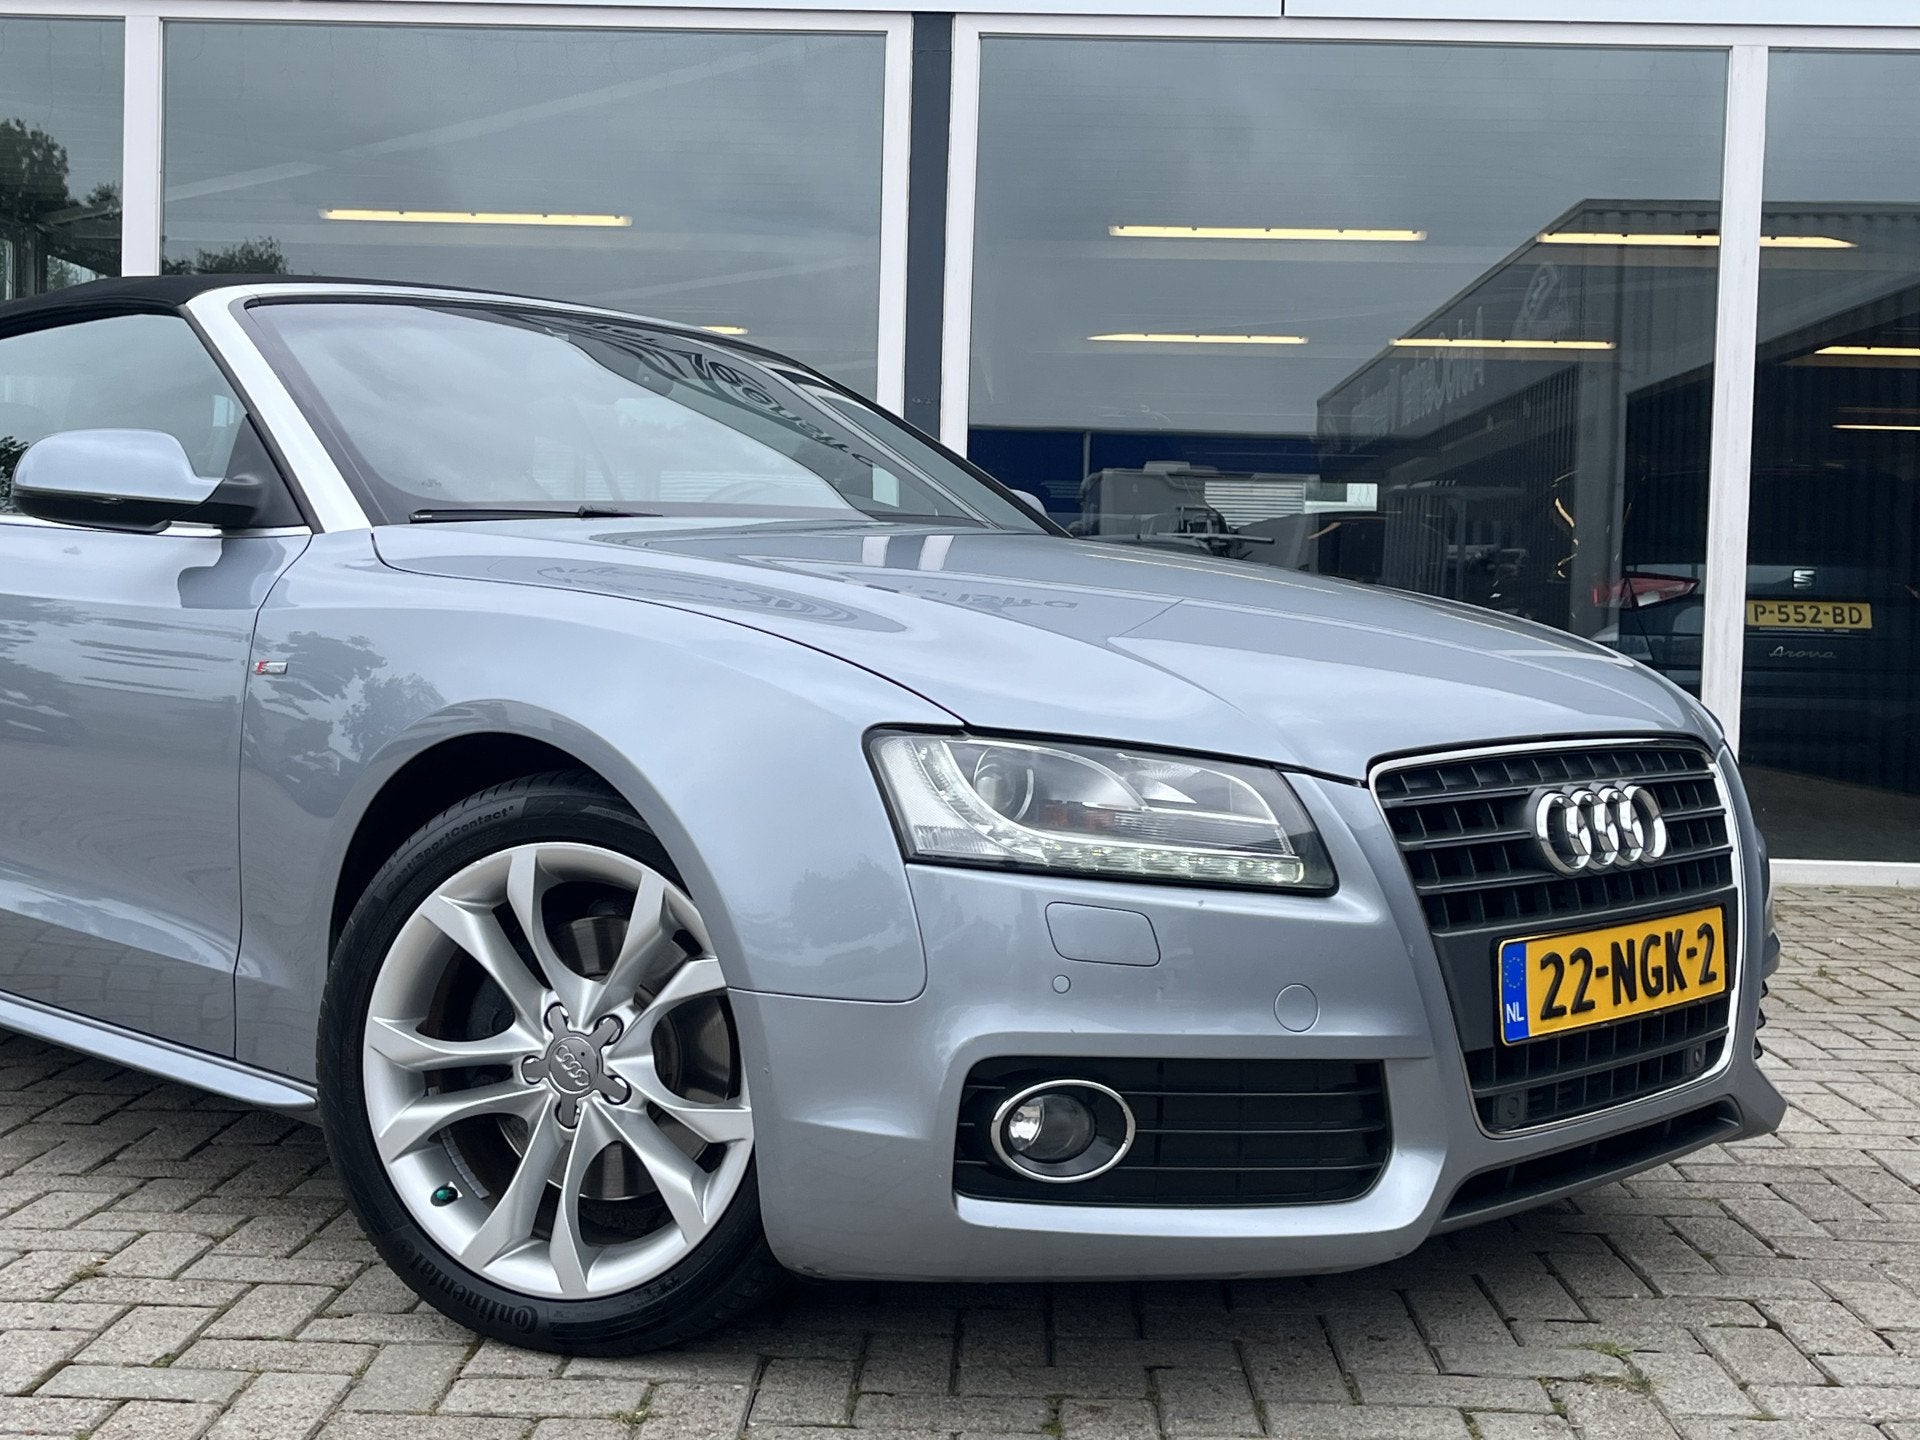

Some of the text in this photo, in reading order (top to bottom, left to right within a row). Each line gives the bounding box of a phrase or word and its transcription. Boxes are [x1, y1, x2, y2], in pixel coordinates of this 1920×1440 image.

[1754, 603, 1863, 625] P-552-BD
[1769, 646, 1837, 659] Arona
[1540, 922, 1717, 1021] 22-NGK-2
[1506, 1001, 1525, 1024] NL
[409, 1252, 539, 1335] Continental
